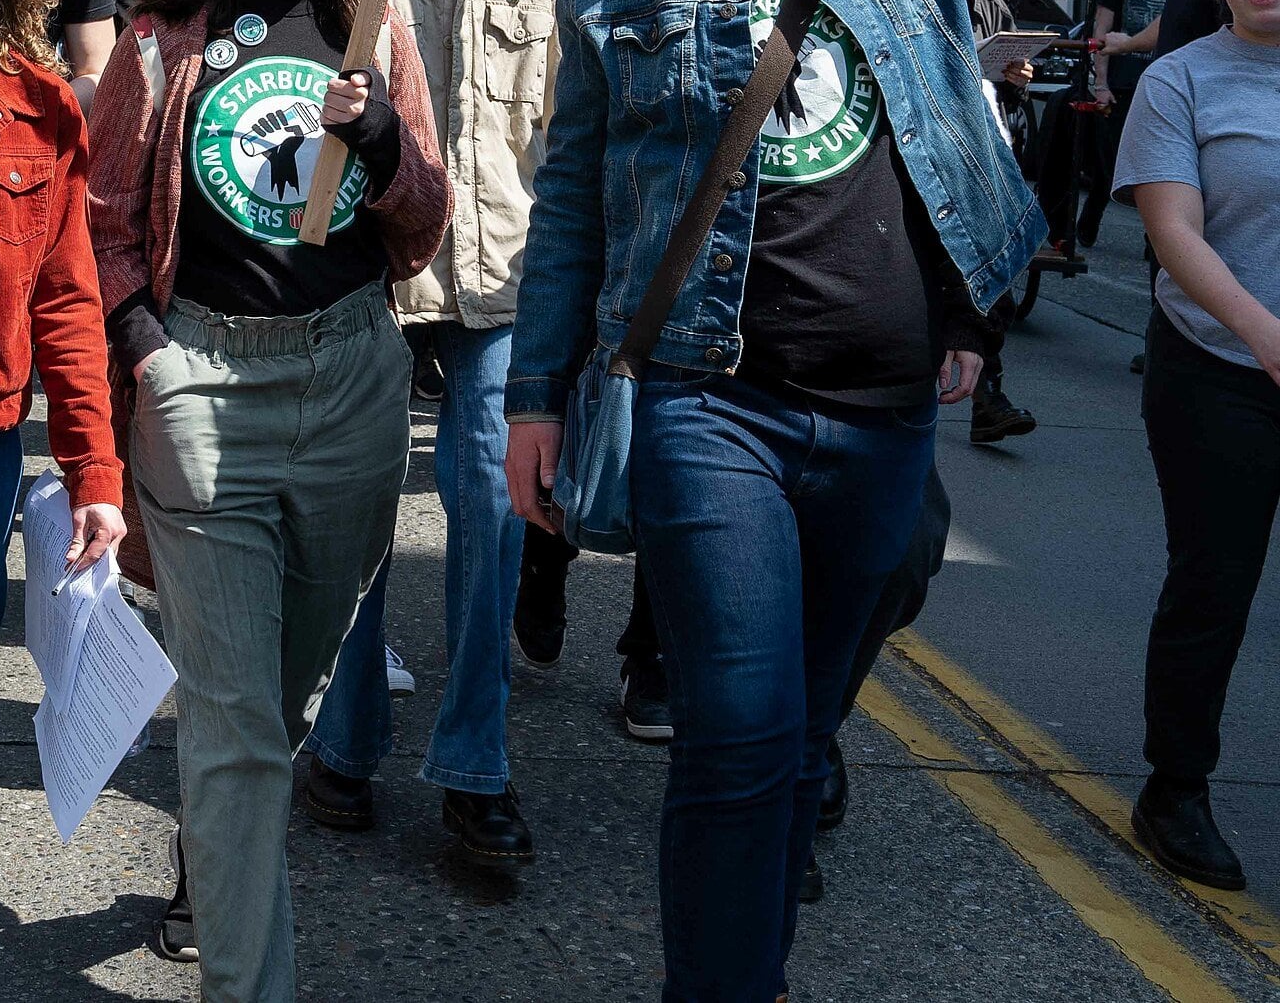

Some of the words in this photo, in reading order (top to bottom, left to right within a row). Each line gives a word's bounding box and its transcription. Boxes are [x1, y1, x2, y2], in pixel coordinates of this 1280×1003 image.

[220, 70, 328, 116] STARBUC
[821, 62, 874, 152] UNITED
[200, 143, 284, 228] WORKERS
